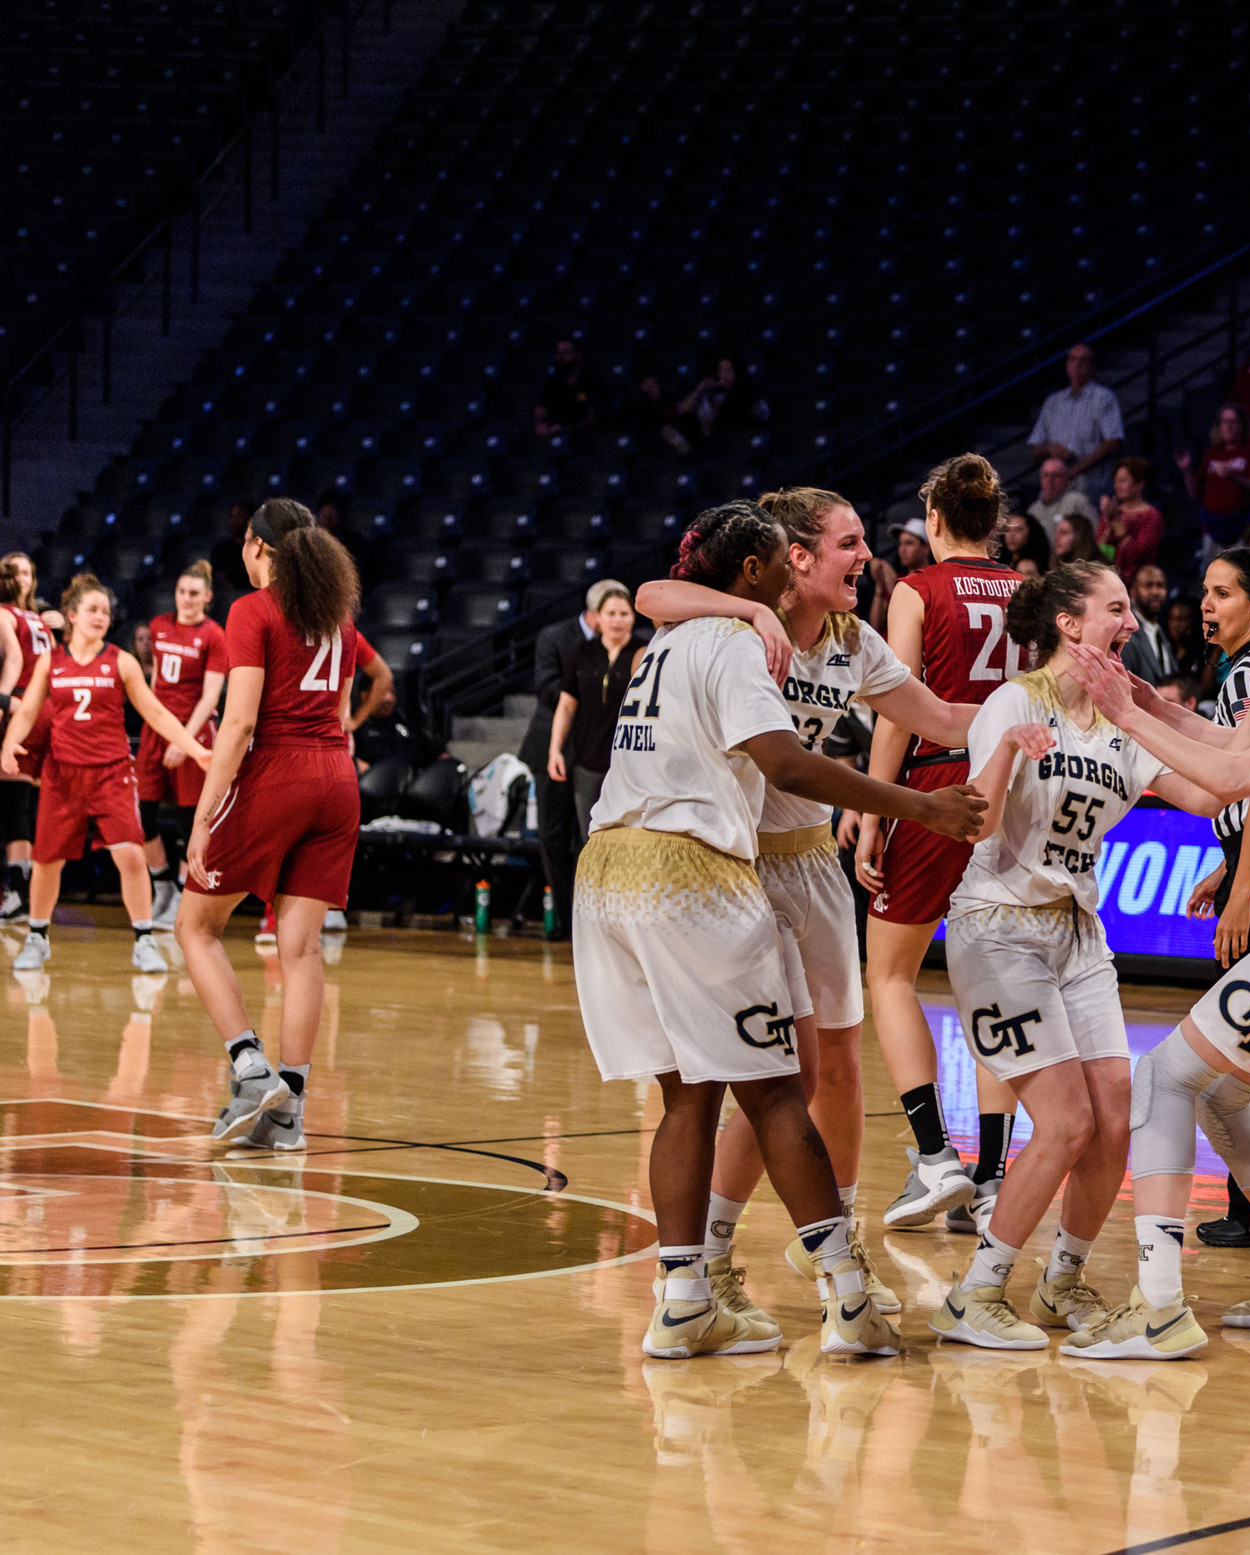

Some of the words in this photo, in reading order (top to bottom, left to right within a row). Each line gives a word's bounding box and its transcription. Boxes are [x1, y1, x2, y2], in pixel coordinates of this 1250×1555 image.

[161, 652, 183, 684] 10
[300, 624, 342, 692] 21
[618, 647, 672, 720] 21
[72, 688, 92, 721] 2
[1038, 751, 1128, 802] GEORGIA
[1051, 790, 1106, 842] 55
